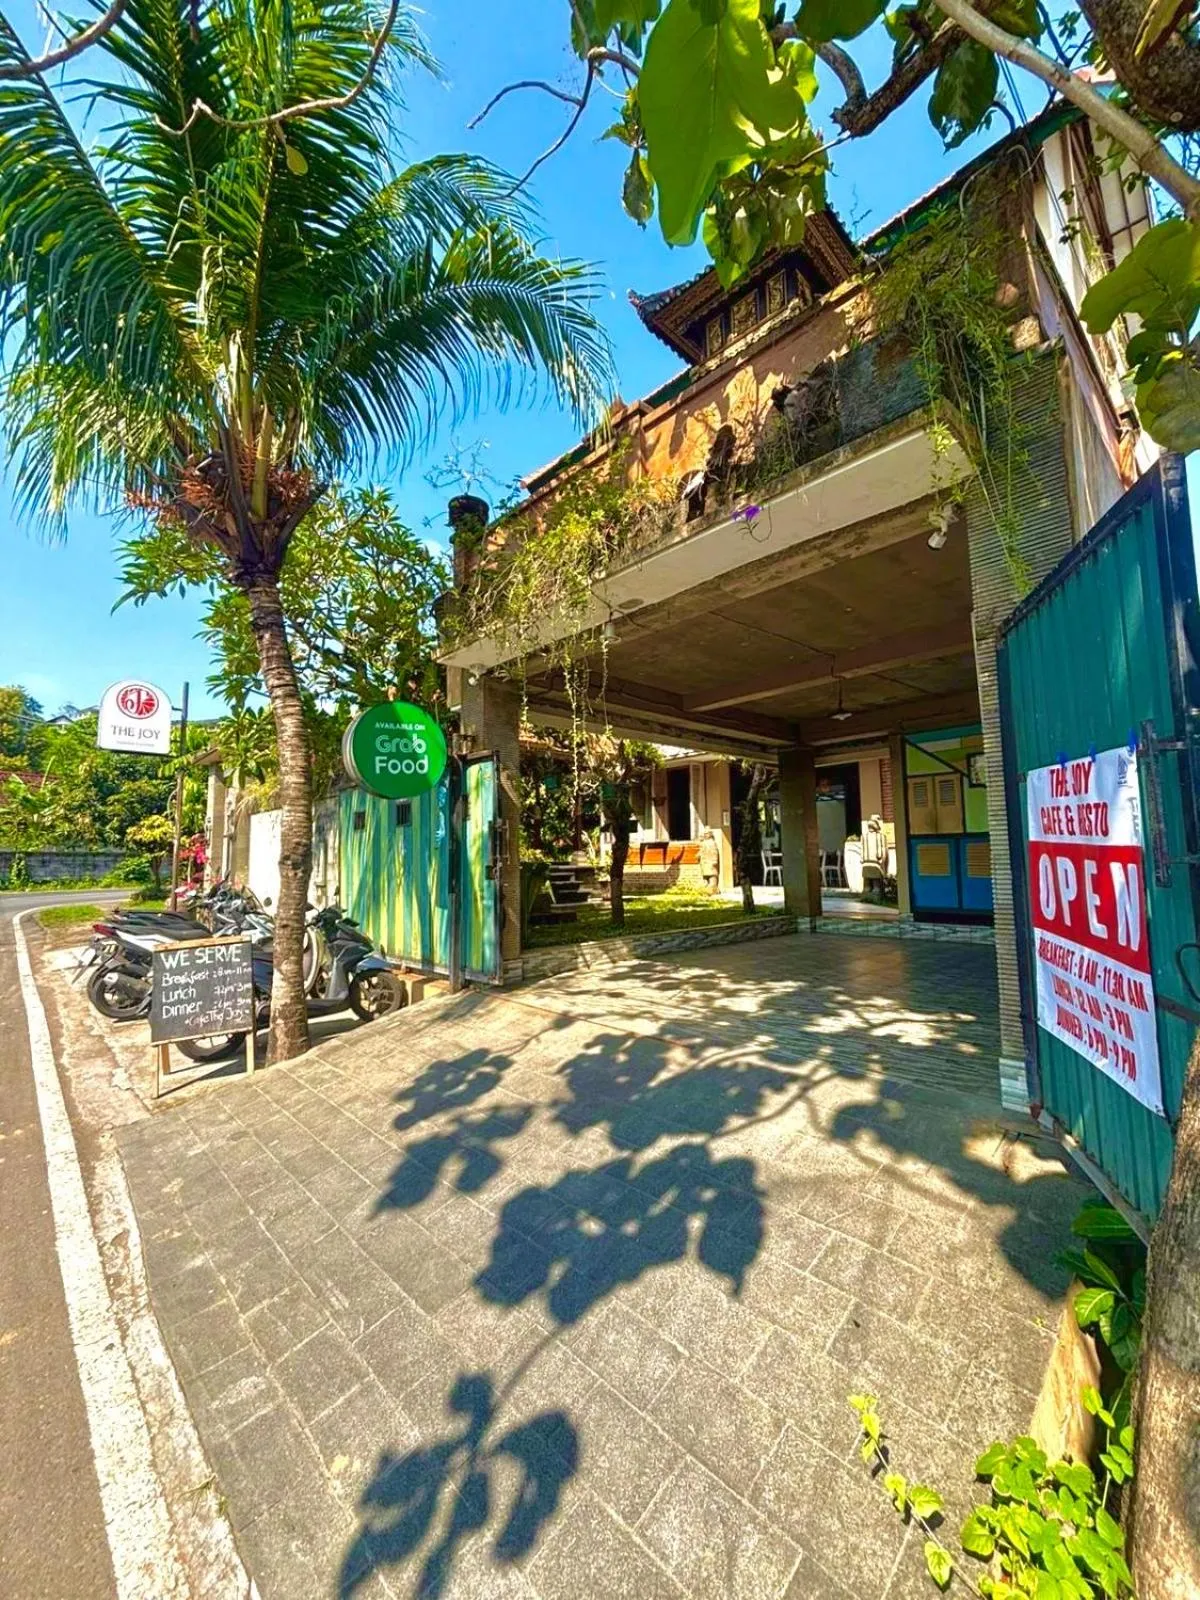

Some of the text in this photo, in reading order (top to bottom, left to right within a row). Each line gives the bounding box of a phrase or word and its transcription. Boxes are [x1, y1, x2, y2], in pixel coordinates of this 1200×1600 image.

[111, 725, 160, 740] THE JOY
[375, 722, 413, 731] AVAILABLE
[375, 733, 427, 754] Grab
[374, 754, 429, 775] Food
[1050, 761, 1092, 798] THE JOY
[1041, 805, 1064, 836] CAFE
[1064, 804, 1076, 837] &
[1039, 853, 1140, 952] OPEN
[160, 944, 242, 970] WE SERVE
[1038, 936, 1075, 975] BREAKFAST
[1127, 977, 1149, 1013] AM
[162, 985, 197, 1003] Lunch
[1114, 1007, 1135, 1042] PM
[1093, 1027, 1109, 1060] PM
[1121, 1045, 1137, 1082] PM
